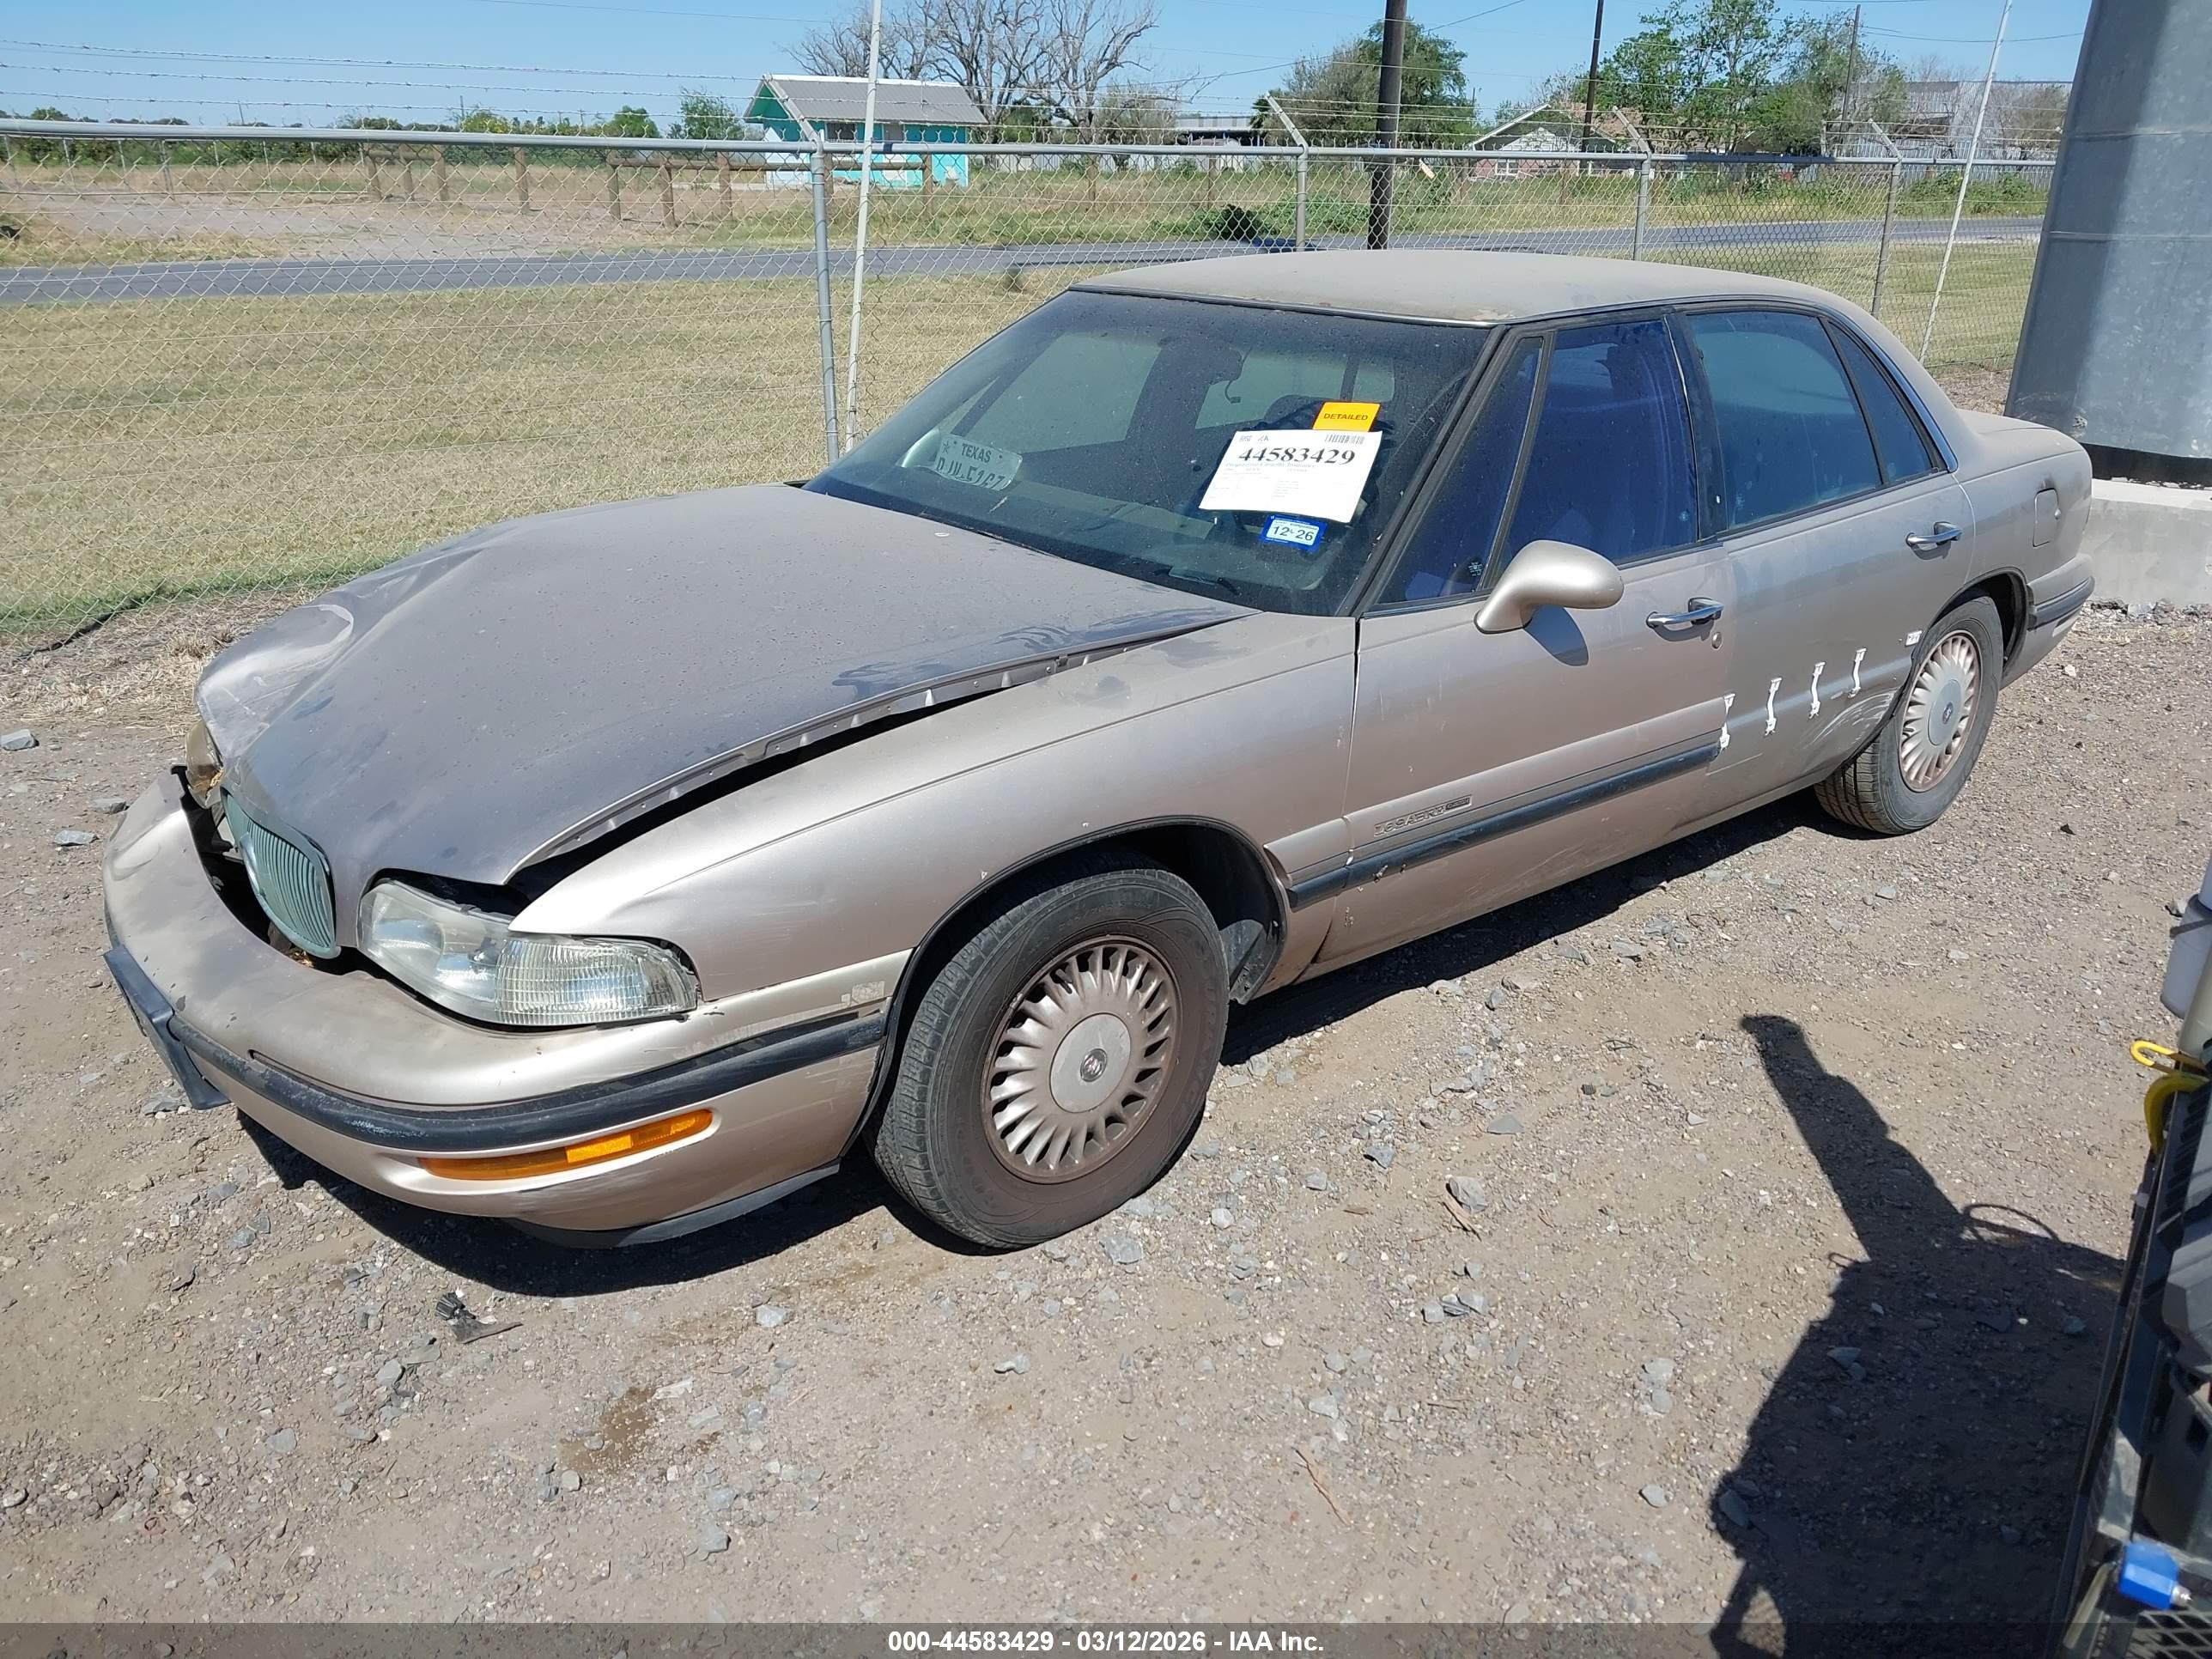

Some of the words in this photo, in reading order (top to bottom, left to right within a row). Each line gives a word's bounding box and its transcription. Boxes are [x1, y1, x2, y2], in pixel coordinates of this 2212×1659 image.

[961, 442, 992, 463] TEXAS
[1238, 447, 1356, 465] 44583429
[1273, 526, 1290, 537] 12
[1295, 529, 1315, 541] 26
